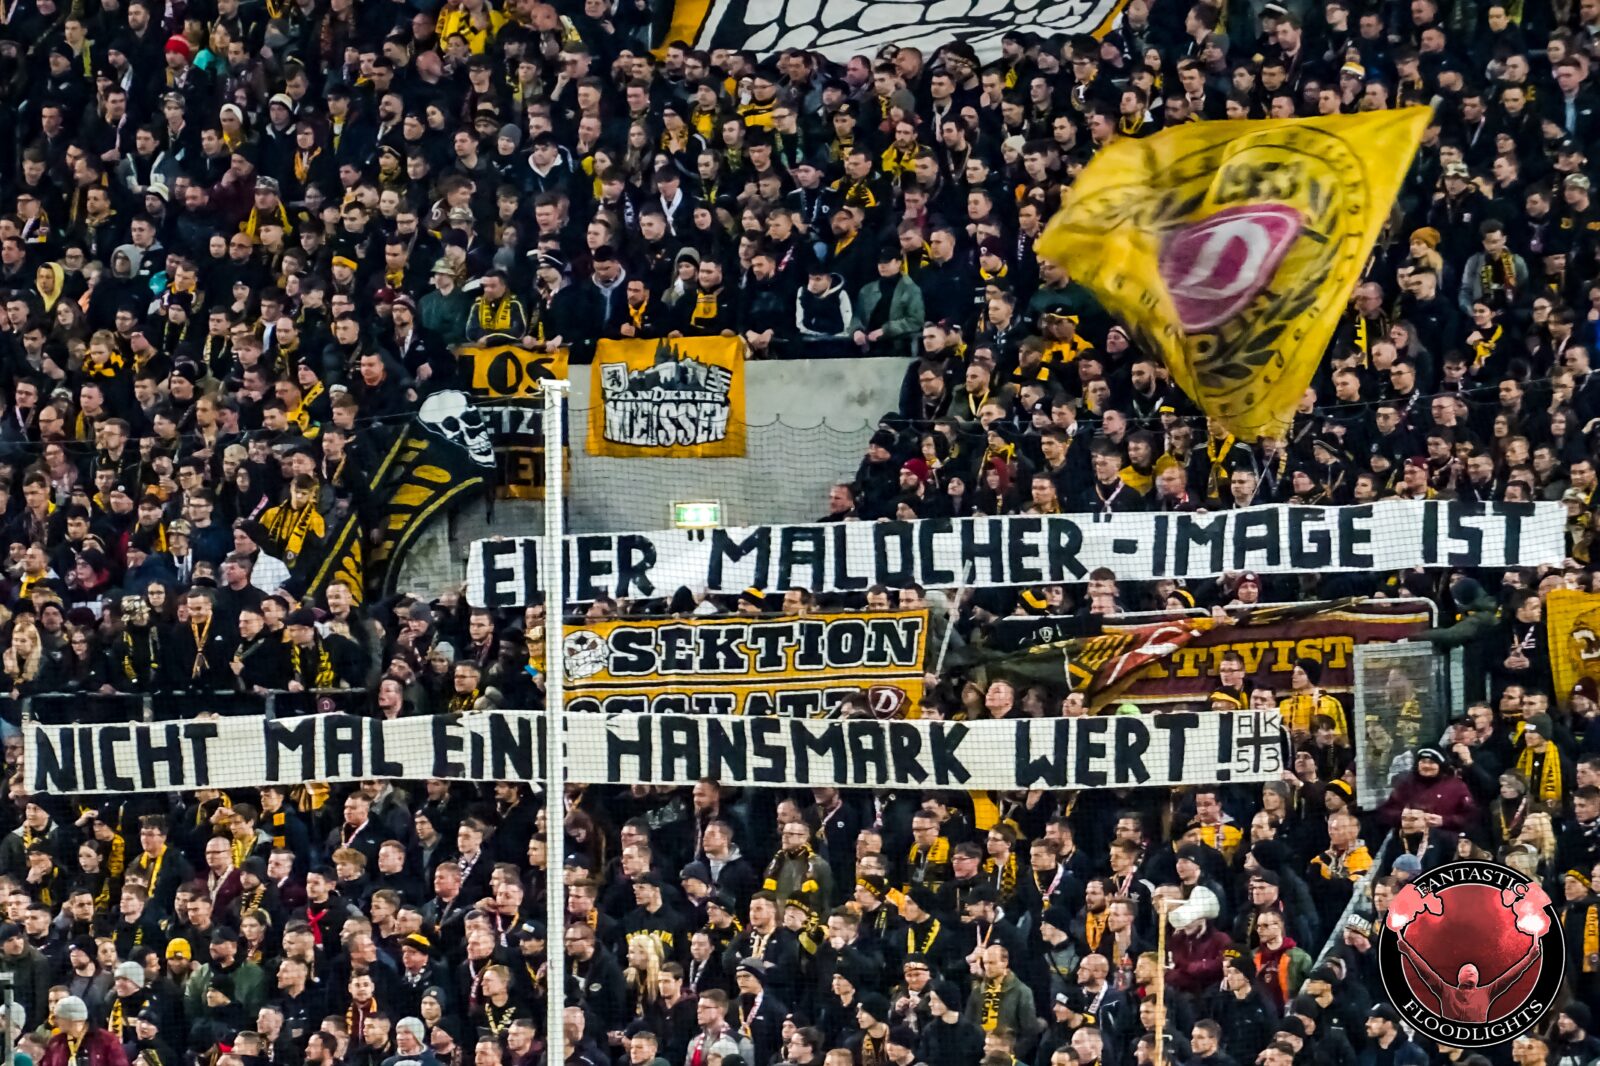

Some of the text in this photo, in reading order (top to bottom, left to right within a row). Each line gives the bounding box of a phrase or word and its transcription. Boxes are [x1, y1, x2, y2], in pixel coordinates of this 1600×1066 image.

[606, 386, 725, 401] LANDKREIS
[604, 401, 730, 446] MEISSEN
[1422, 501, 1536, 566] IST
[607, 619, 923, 676] SEKTION
[35, 723, 218, 792] NICHT
[264, 714, 403, 782] MAL
[606, 714, 972, 785] HANSMARK
